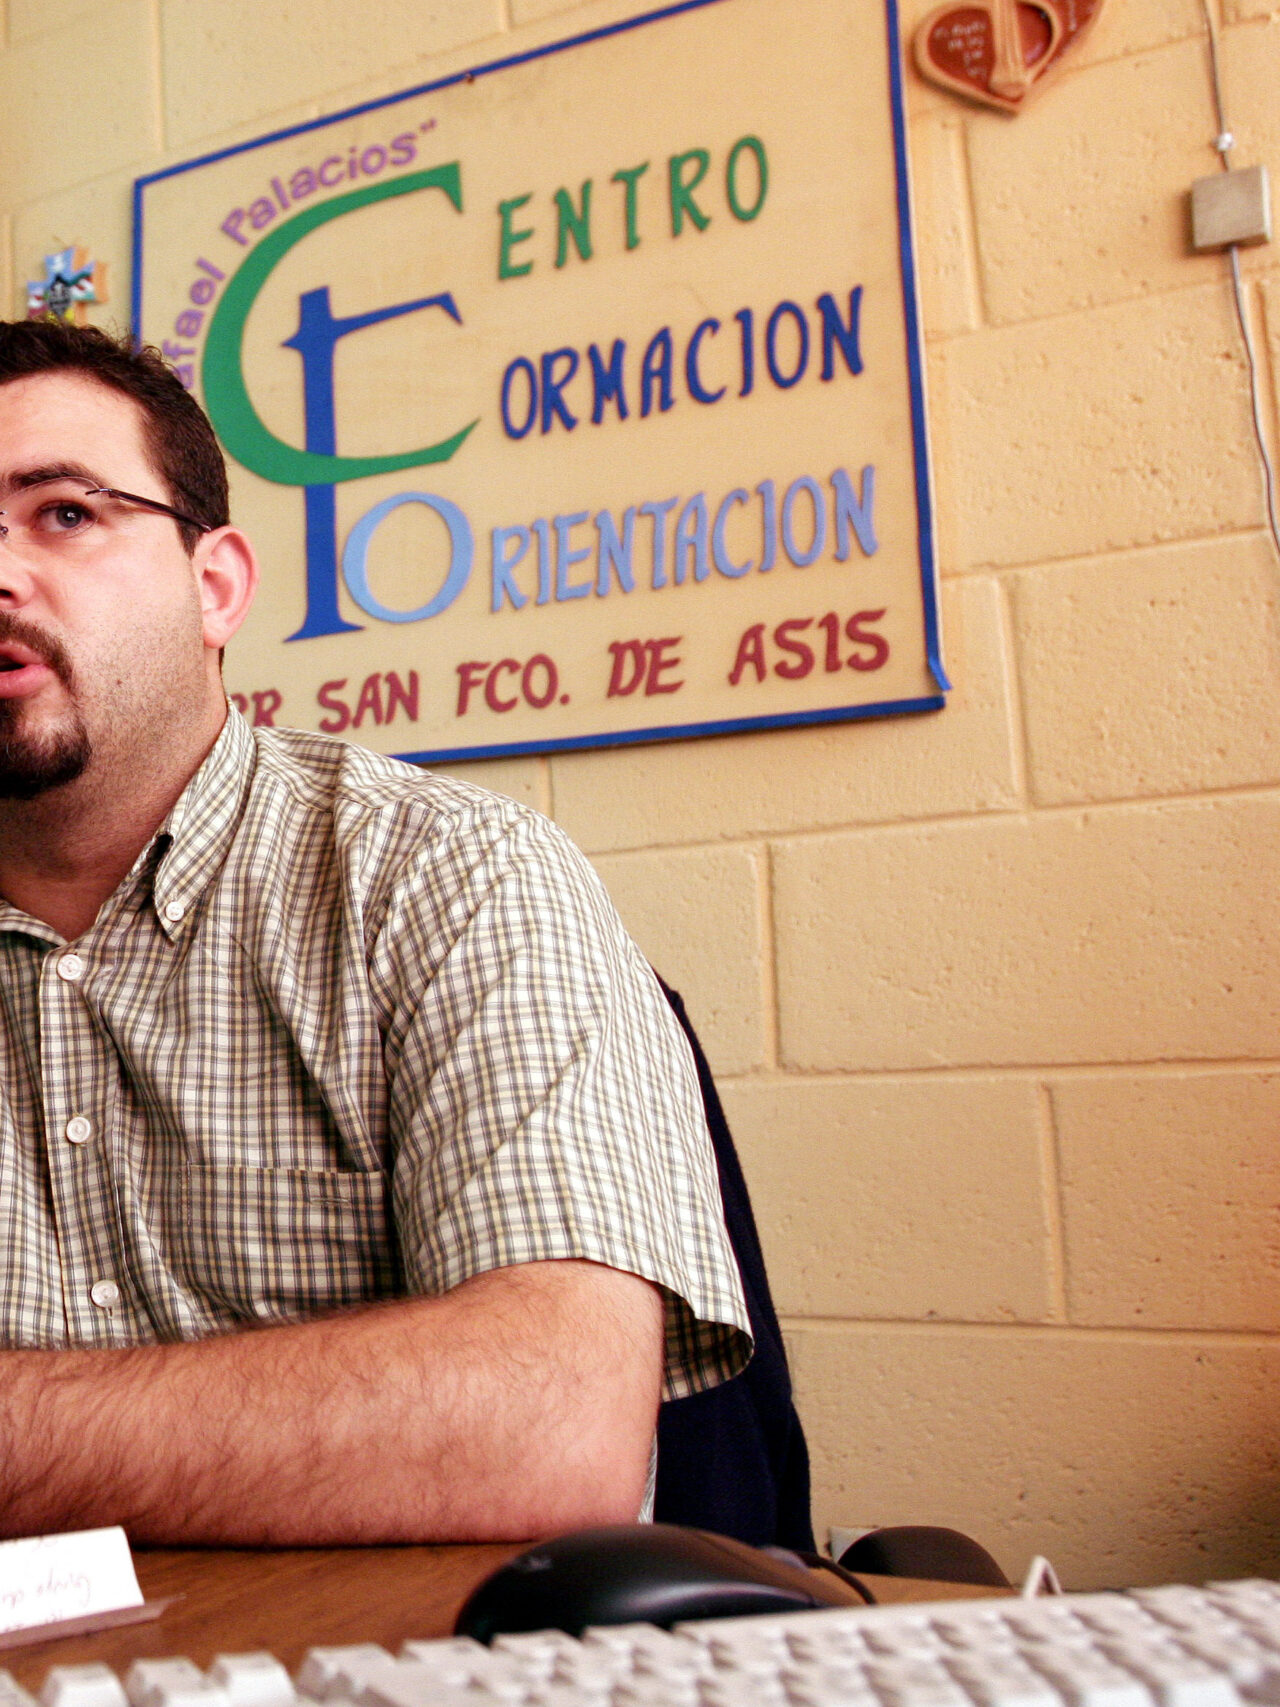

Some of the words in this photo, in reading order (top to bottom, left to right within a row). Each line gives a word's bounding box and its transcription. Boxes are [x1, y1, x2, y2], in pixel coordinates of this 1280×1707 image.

[161, 257, 226, 391] afael
[317, 670, 420, 733] SAN
[456, 653, 571, 717] FCO.
[606, 637, 686, 698] DE
[728, 608, 891, 686] ASIS
